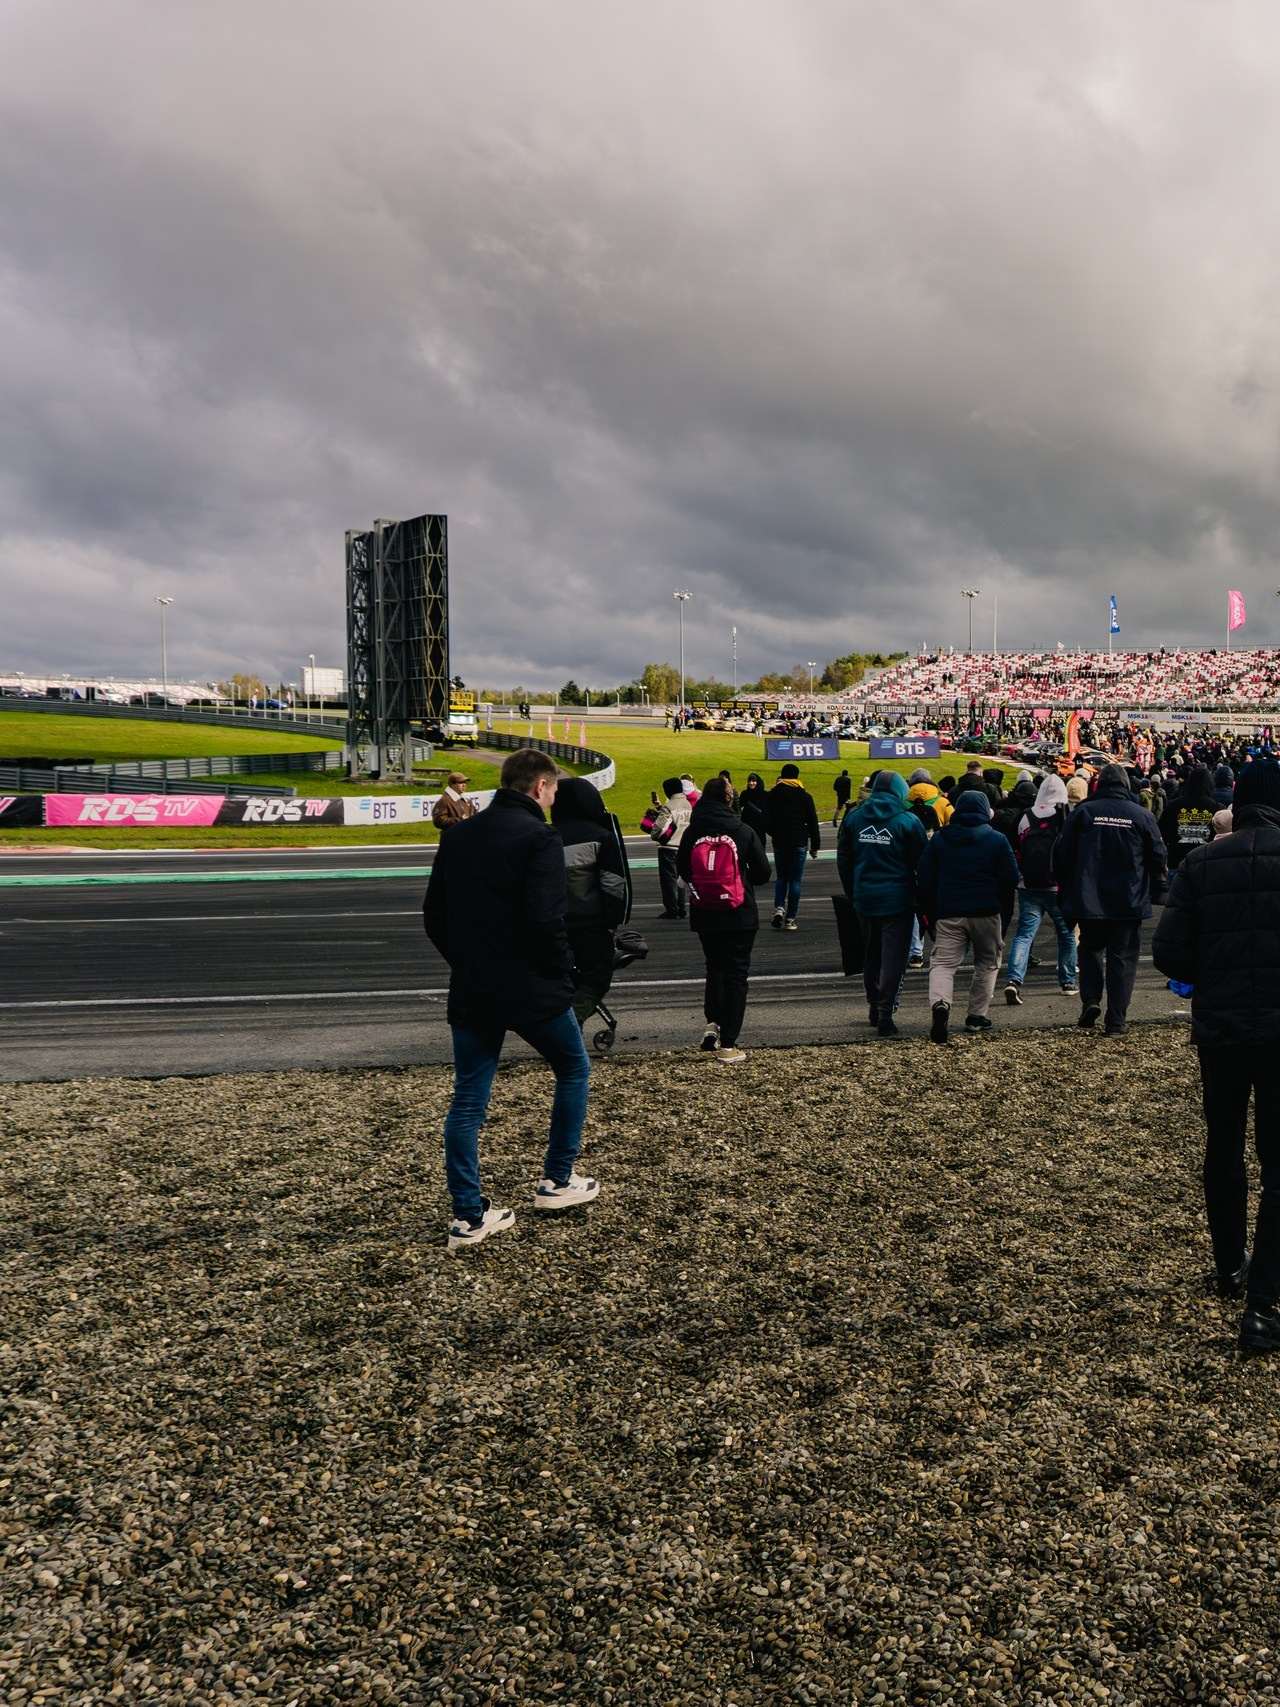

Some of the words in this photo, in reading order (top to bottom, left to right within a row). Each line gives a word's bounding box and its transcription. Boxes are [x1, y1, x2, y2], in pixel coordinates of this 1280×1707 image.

[793, 744, 824, 756] ВТБ
[895, 742, 925, 755] ВТБ
[373, 802, 396, 819] ВТБ
[423, 801, 435, 817] ВТ
